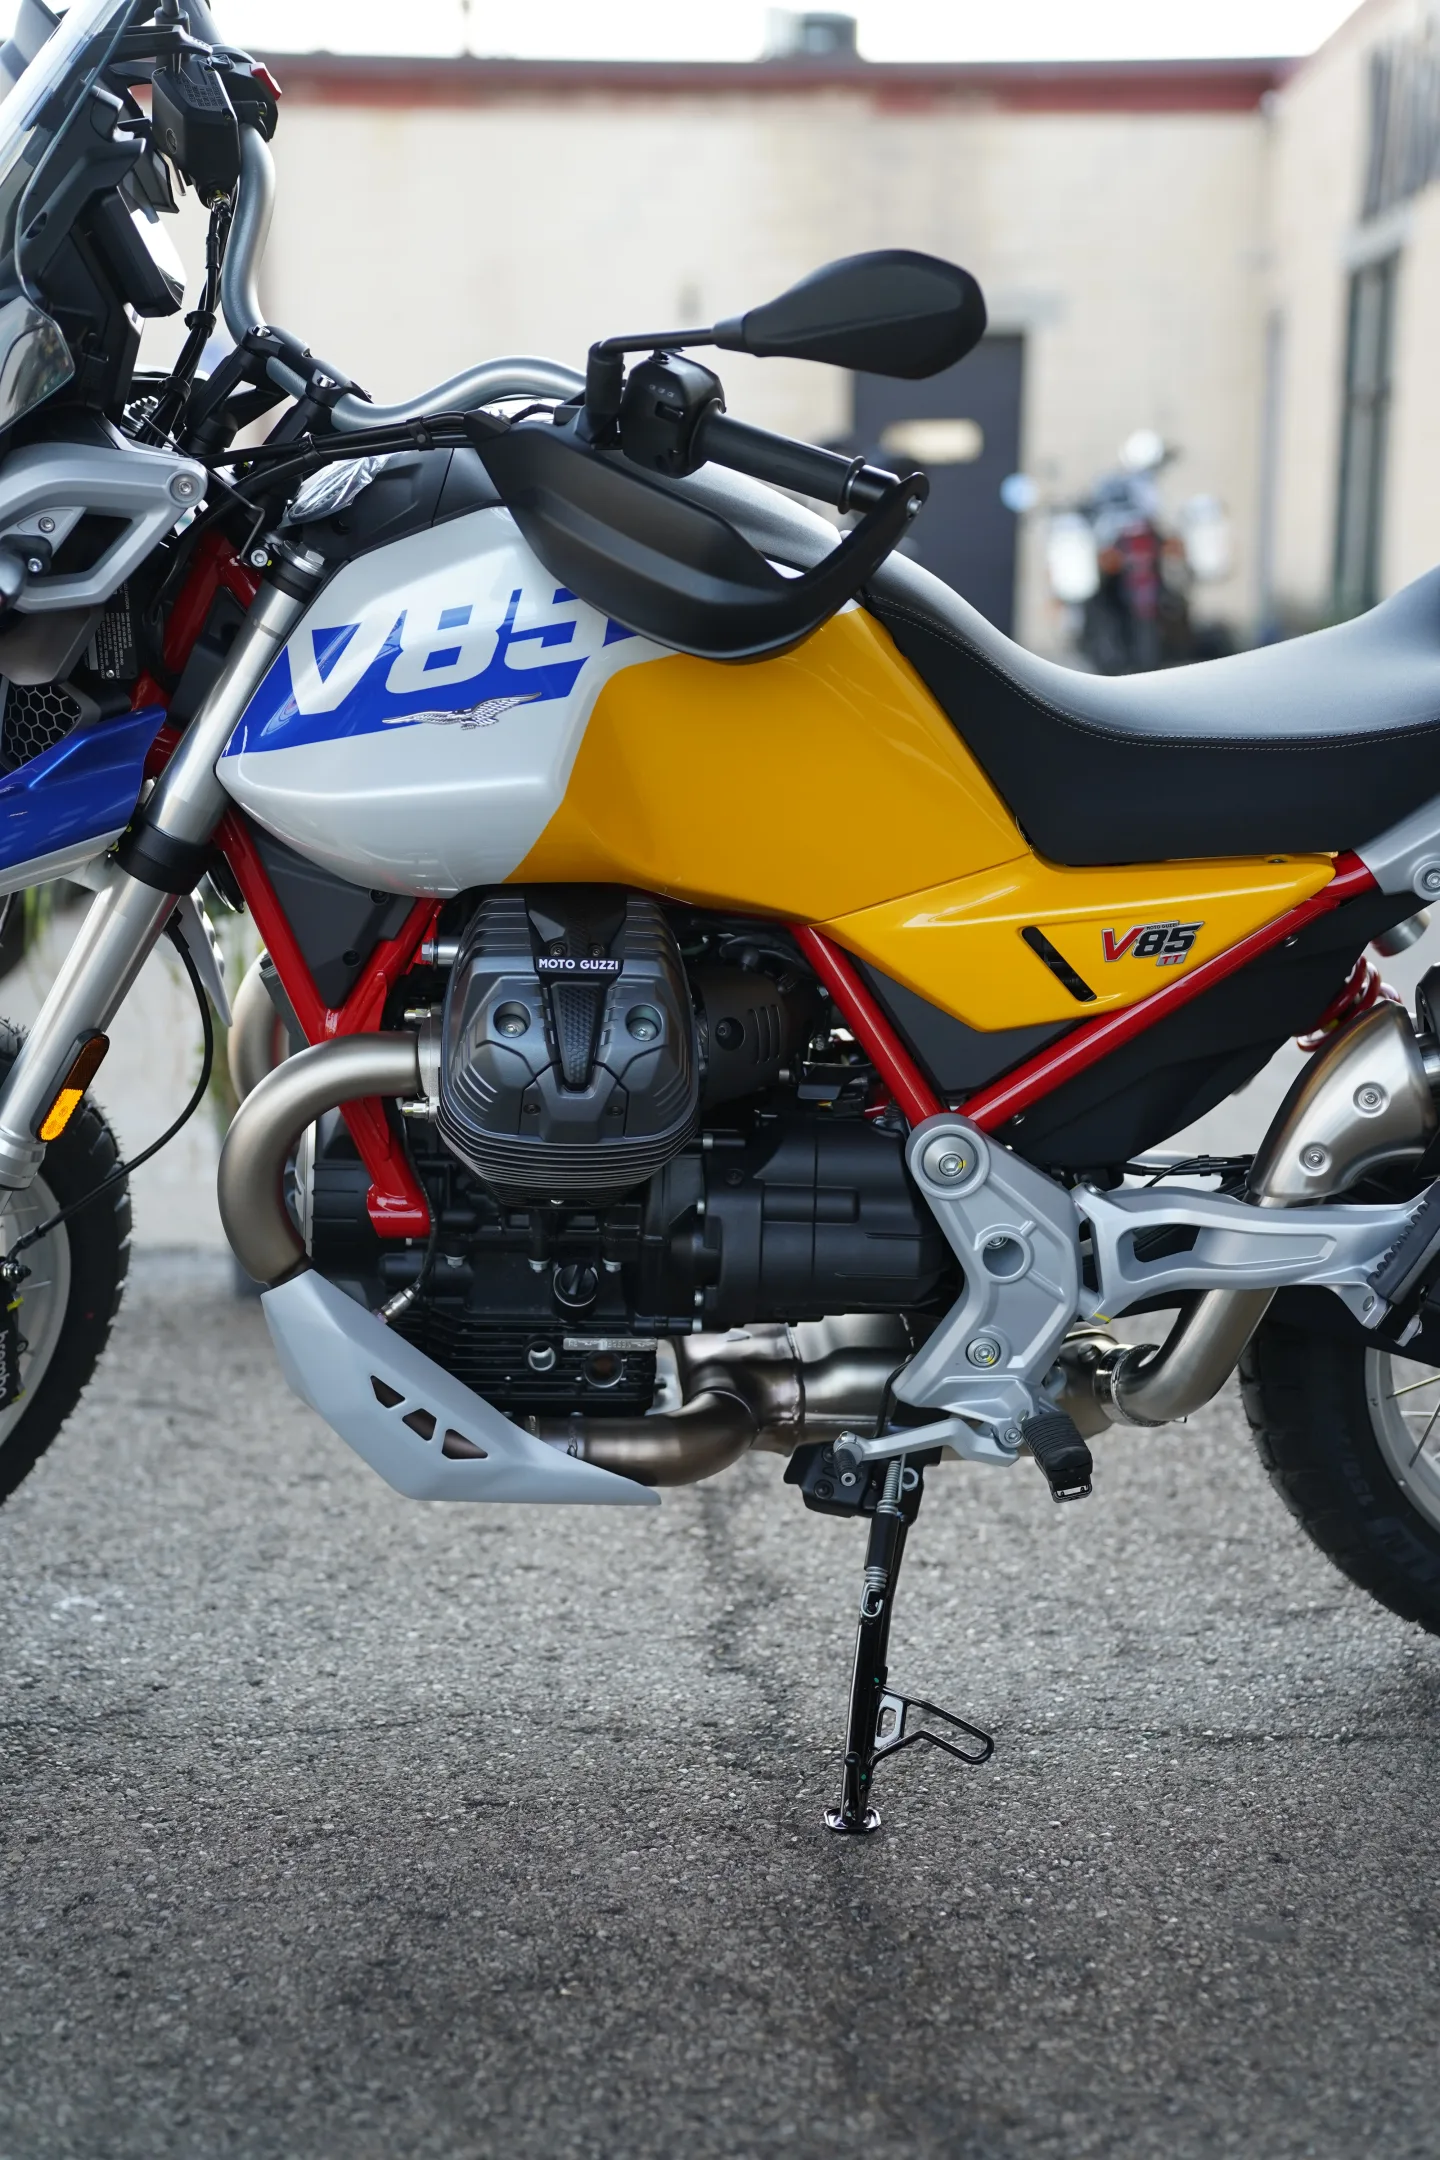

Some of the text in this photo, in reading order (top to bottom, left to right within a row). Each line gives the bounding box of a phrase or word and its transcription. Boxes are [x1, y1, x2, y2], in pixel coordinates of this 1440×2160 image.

[286, 582, 610, 716] V85
[1101, 922, 1203, 962] V85
[538, 958, 619, 970] MOTO GUZZI
[1161, 954, 1183, 965] TT
